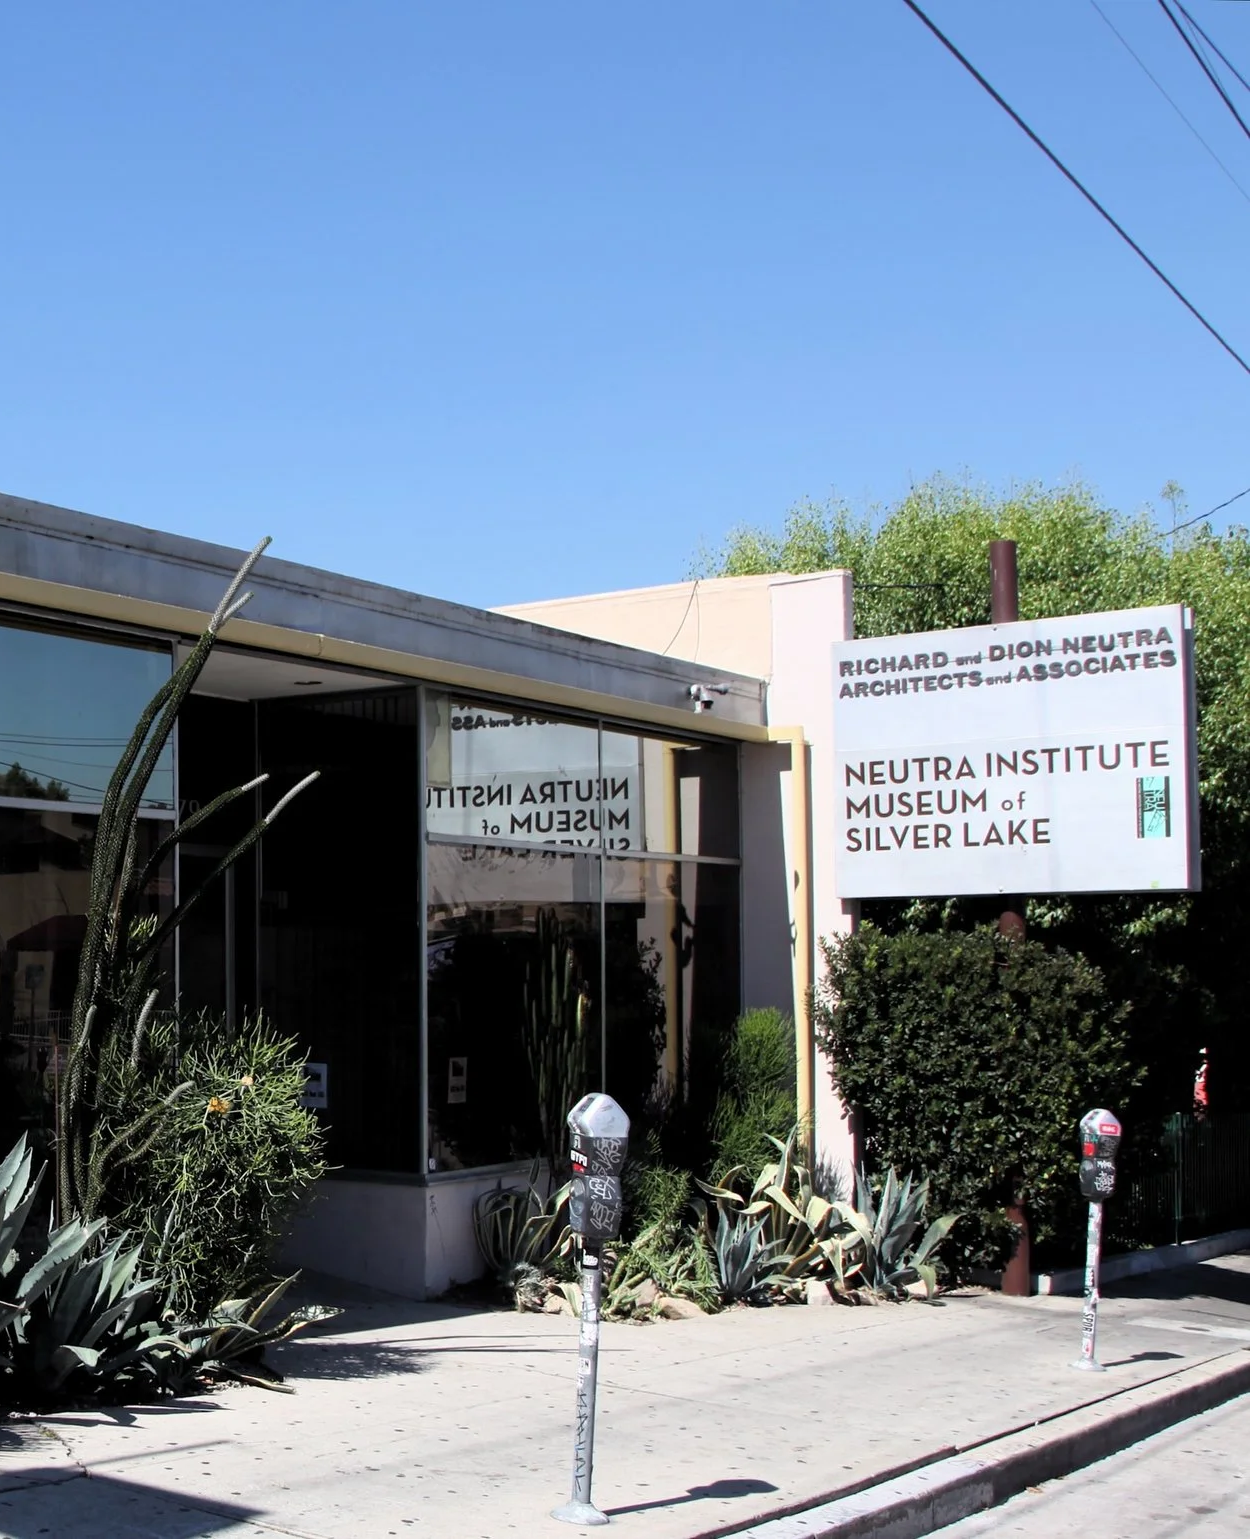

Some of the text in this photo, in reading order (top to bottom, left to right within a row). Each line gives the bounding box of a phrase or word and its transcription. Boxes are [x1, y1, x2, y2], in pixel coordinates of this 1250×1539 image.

[839, 626, 1173, 678] RICHARD and DION NEUTRA
[839, 649, 1177, 699] ARCHITECTS and ASSOCIATES
[845, 740, 1170, 787] NEUTRA INSTITUTE
[846, 789, 1026, 820] MUSEUM of
[846, 818, 1051, 852] SILVER LAKE
